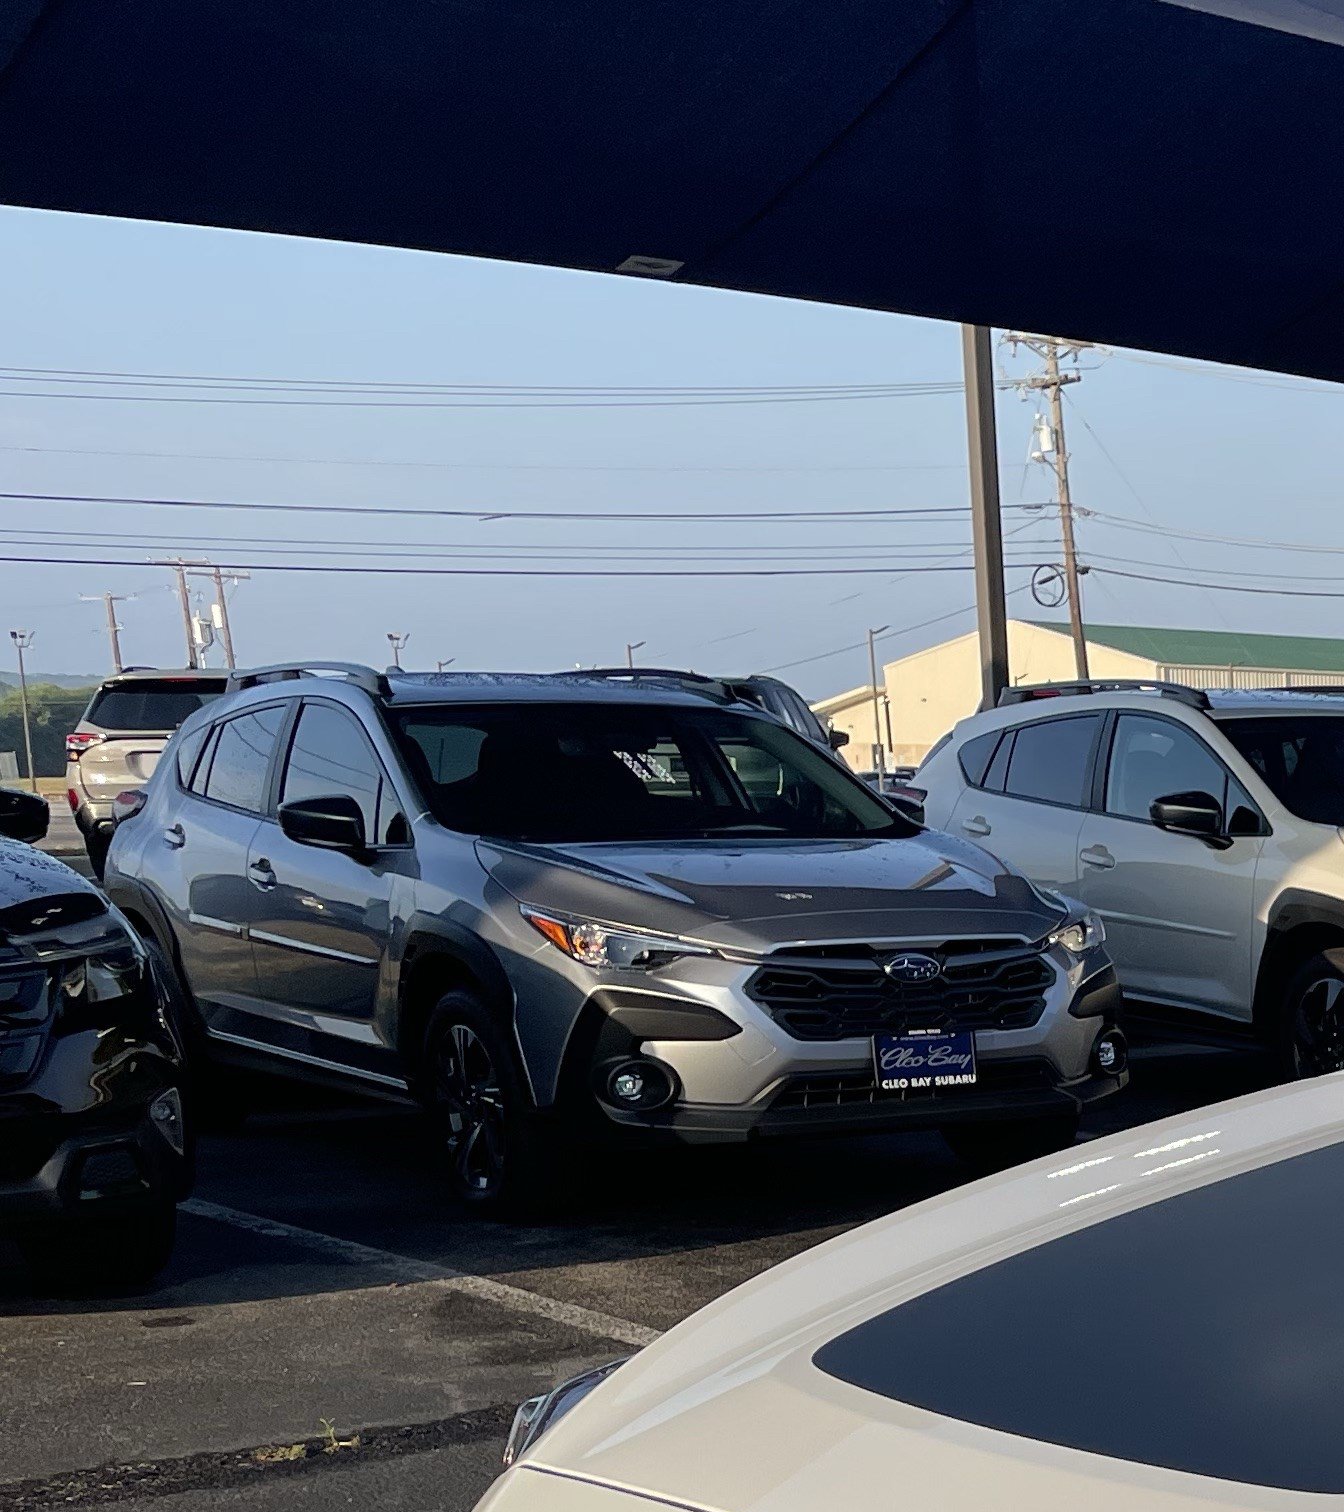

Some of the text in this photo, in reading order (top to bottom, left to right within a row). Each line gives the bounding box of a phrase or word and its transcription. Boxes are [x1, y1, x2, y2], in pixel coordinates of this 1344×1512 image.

[880, 1045, 972, 1070] Cleo Bay
[882, 1073, 977, 1090] CLEO BAY SUBARU
